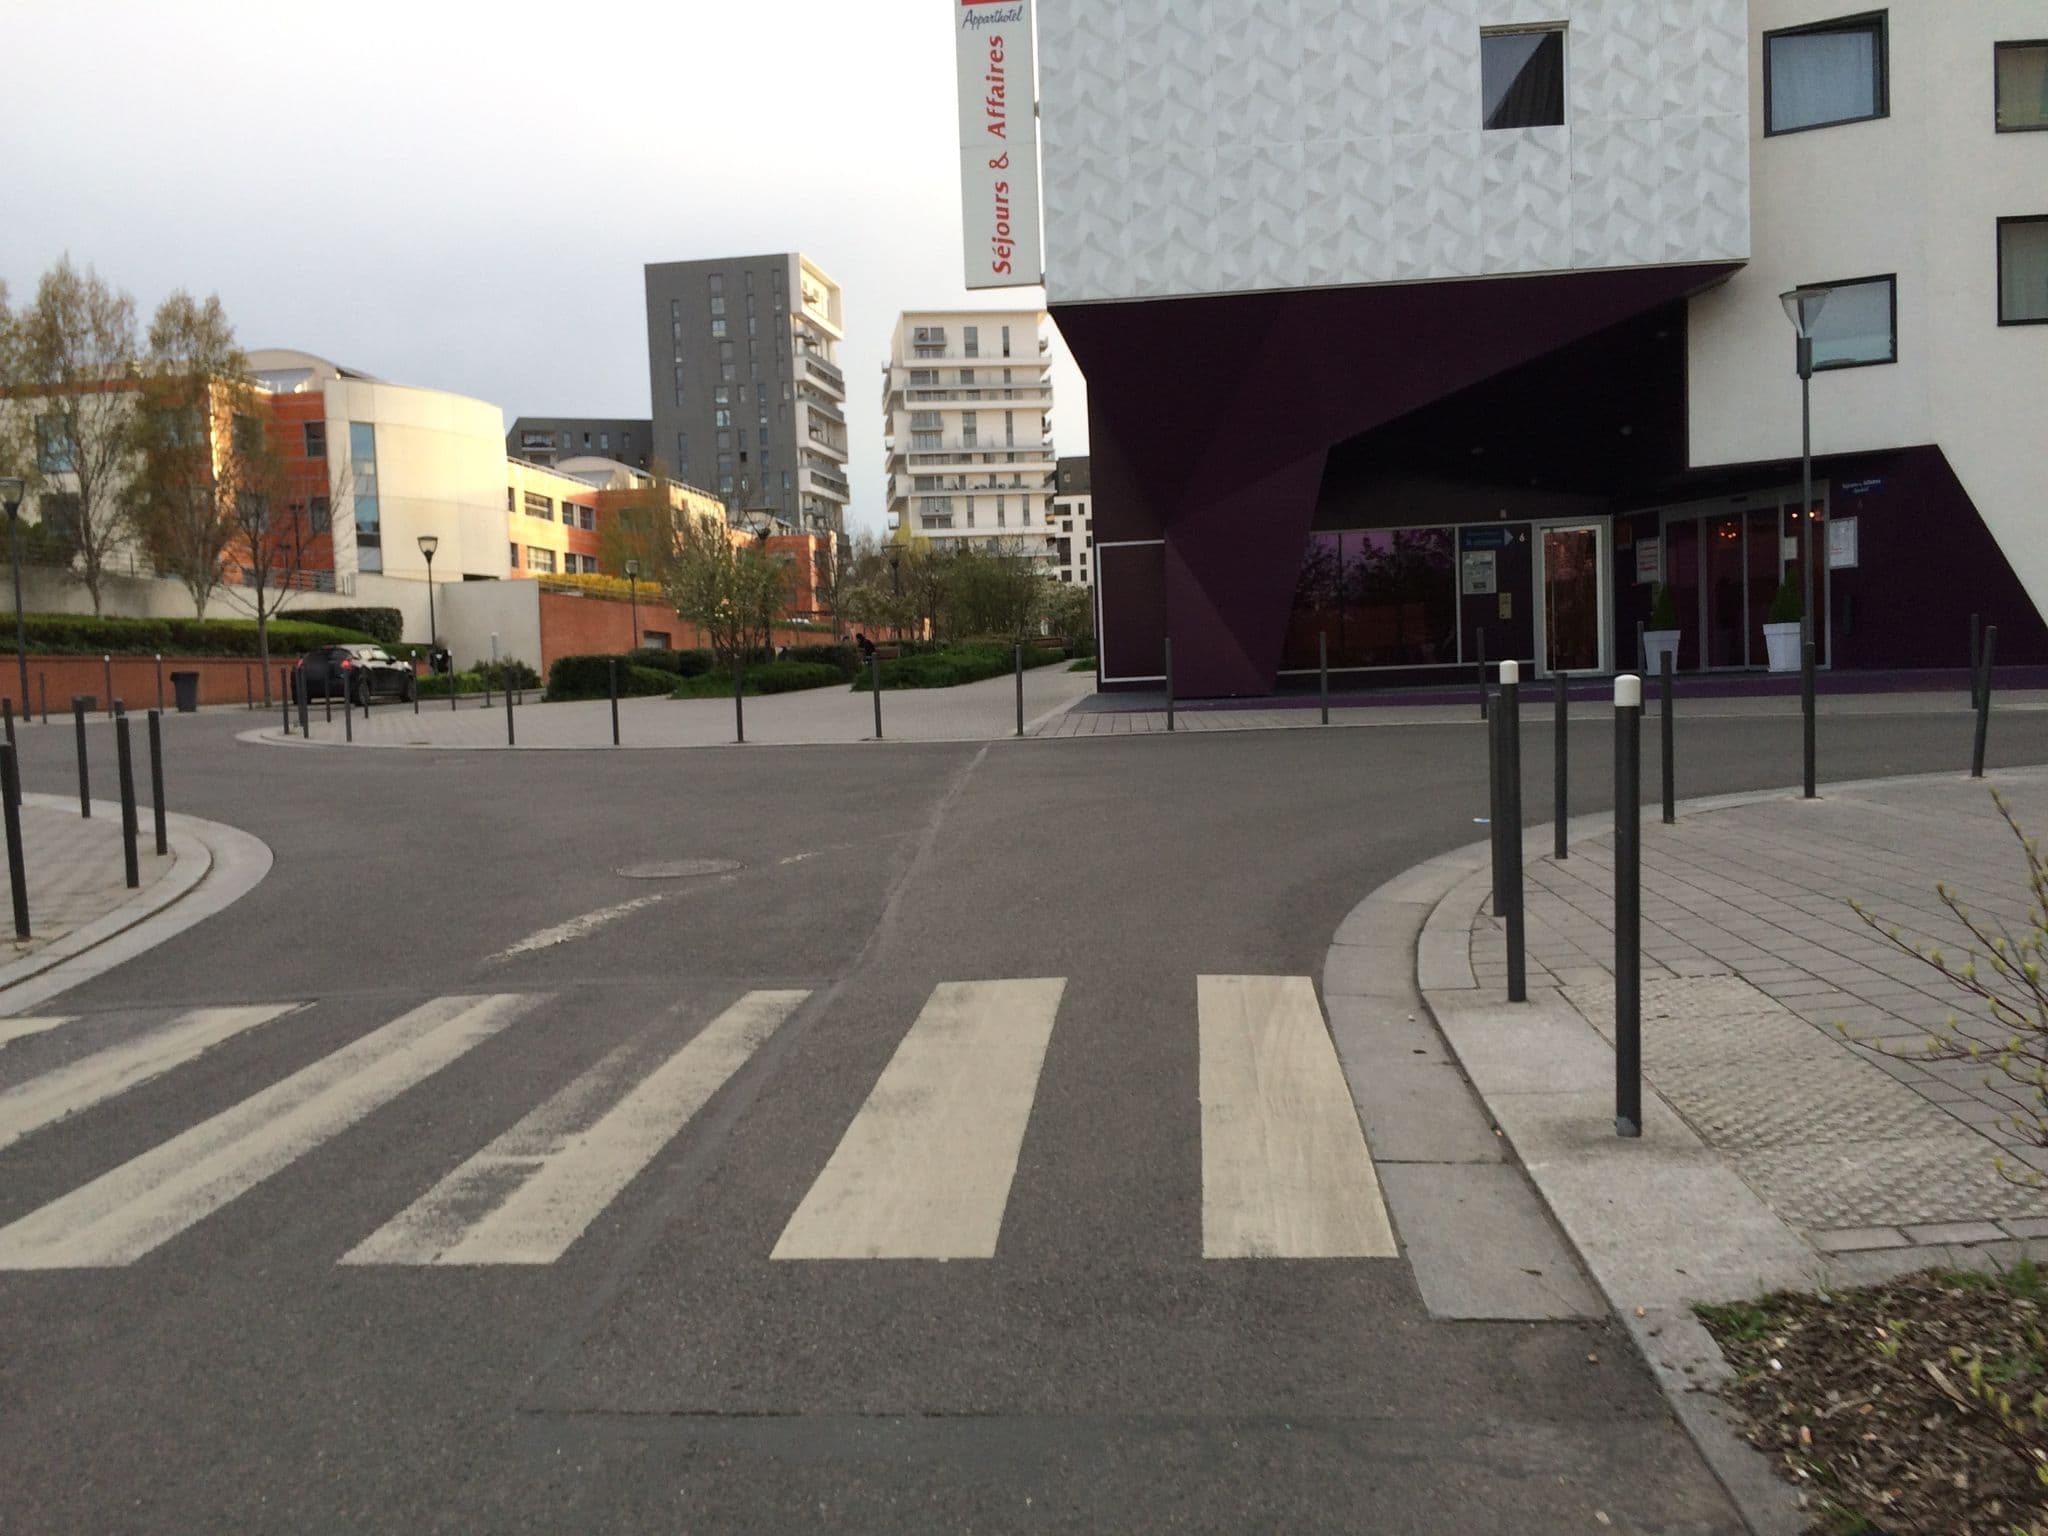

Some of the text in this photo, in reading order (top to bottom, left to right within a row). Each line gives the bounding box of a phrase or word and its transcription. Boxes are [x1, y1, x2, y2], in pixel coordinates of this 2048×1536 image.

[962, 6, 1023, 30] Apparthotel
[985, 35, 1015, 274] Séjours & Affaires
